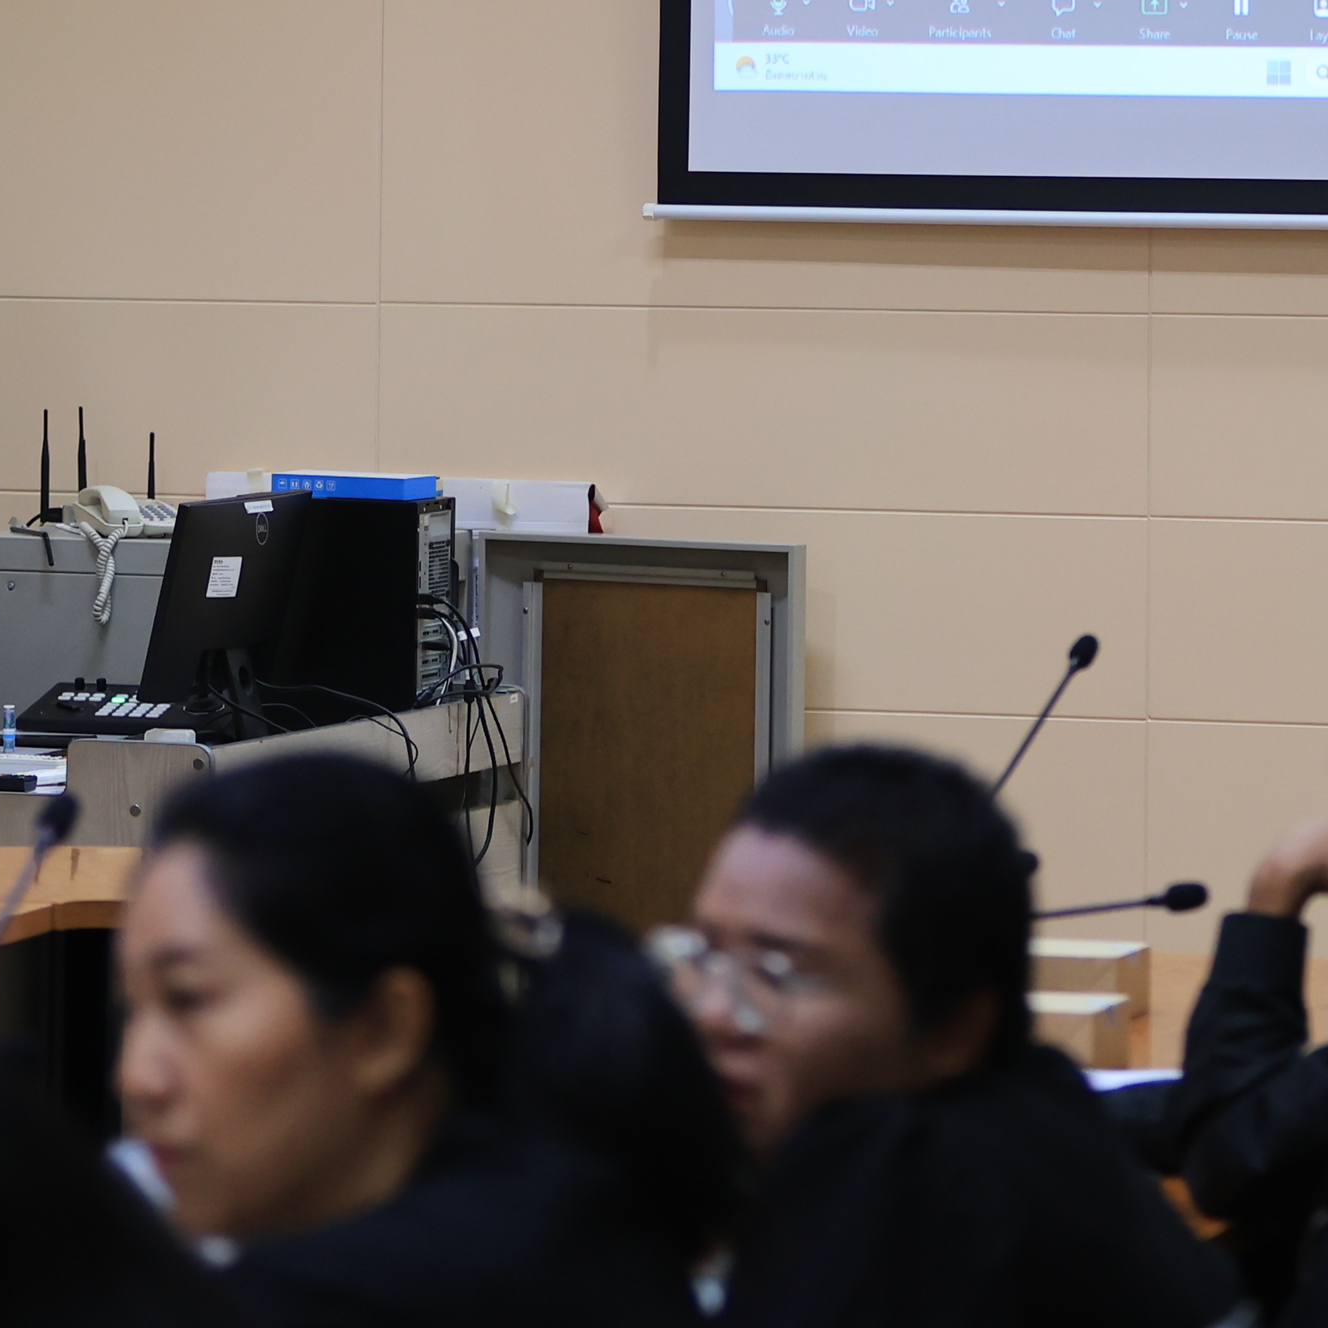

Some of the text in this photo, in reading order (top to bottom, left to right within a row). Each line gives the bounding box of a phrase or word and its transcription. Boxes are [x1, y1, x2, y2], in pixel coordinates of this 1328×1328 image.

[762, 25, 795, 38] Audio
[846, 25, 879, 38] Video
[928, 25, 992, 41] Participants
[1051, 26, 1076, 40] Chat
[1139, 27, 1171, 41] Share
[1226, 28, 1259, 42] Pause
